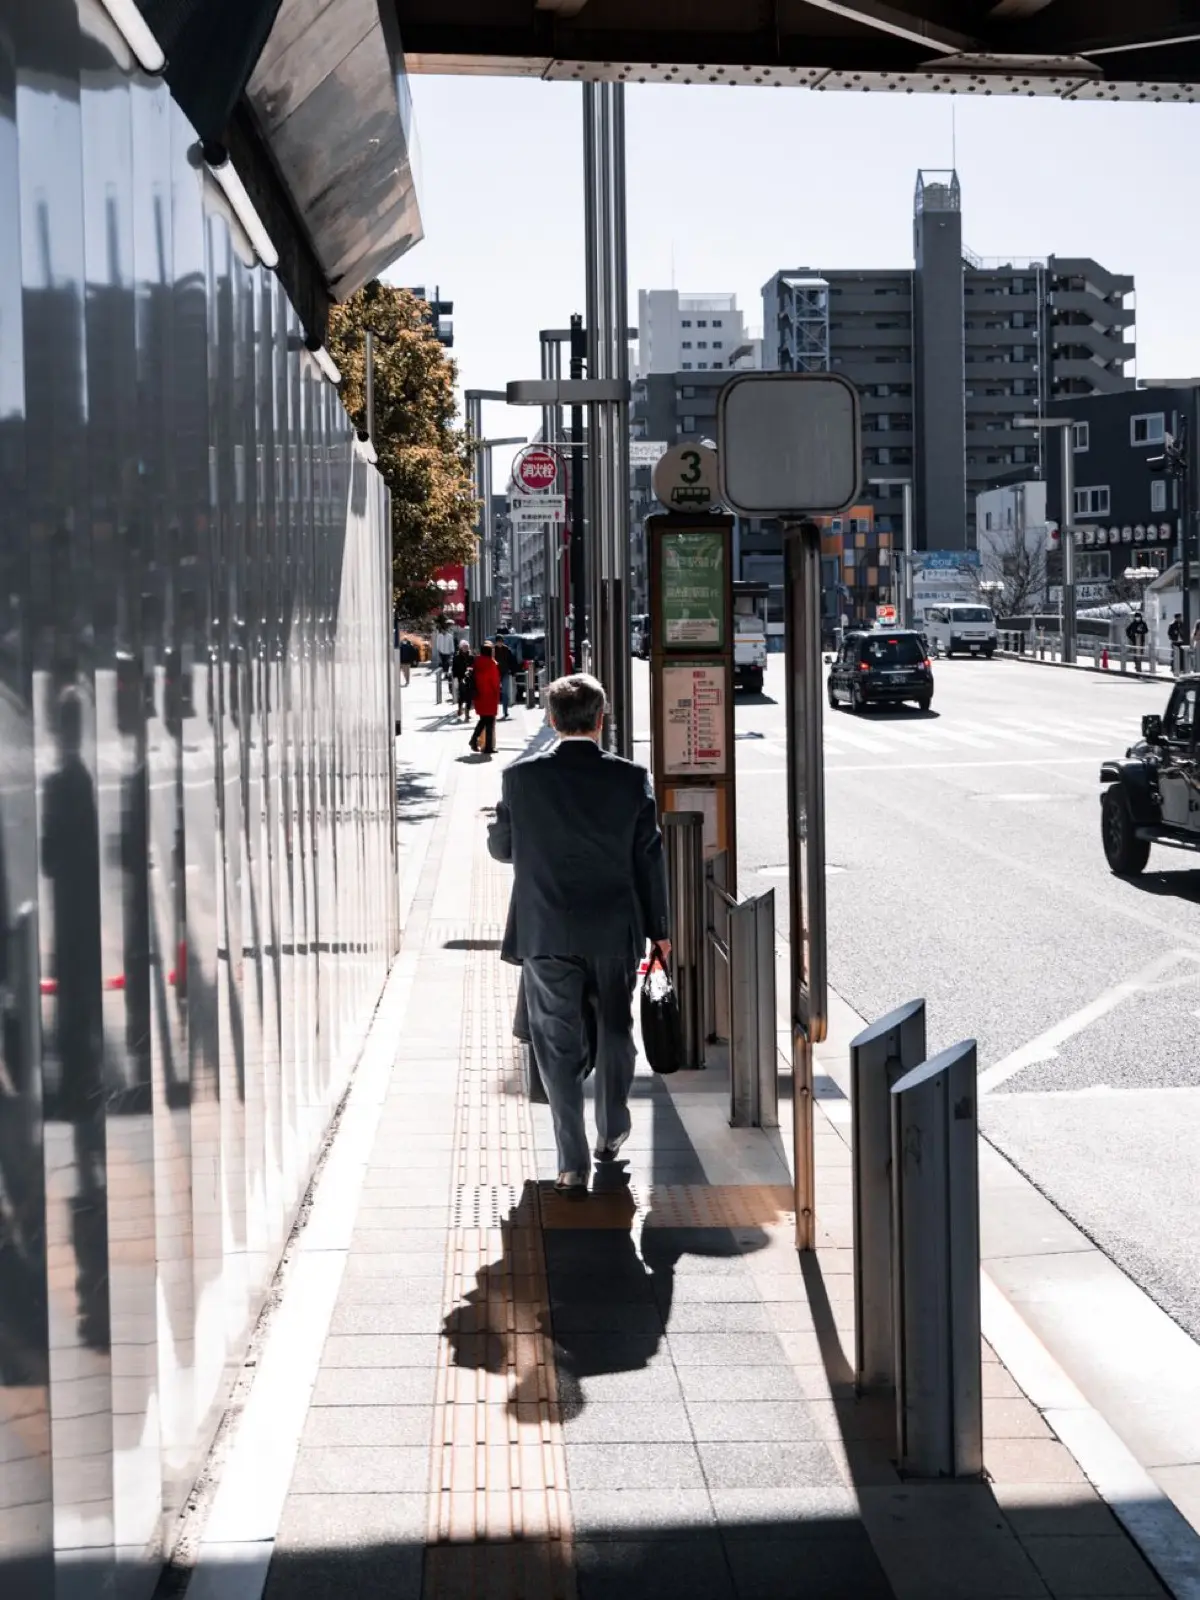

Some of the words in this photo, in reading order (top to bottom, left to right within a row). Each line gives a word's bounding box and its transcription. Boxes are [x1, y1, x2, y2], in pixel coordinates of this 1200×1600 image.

[523, 463, 554, 478] 消火栓
[680, 451, 701, 482] 3
